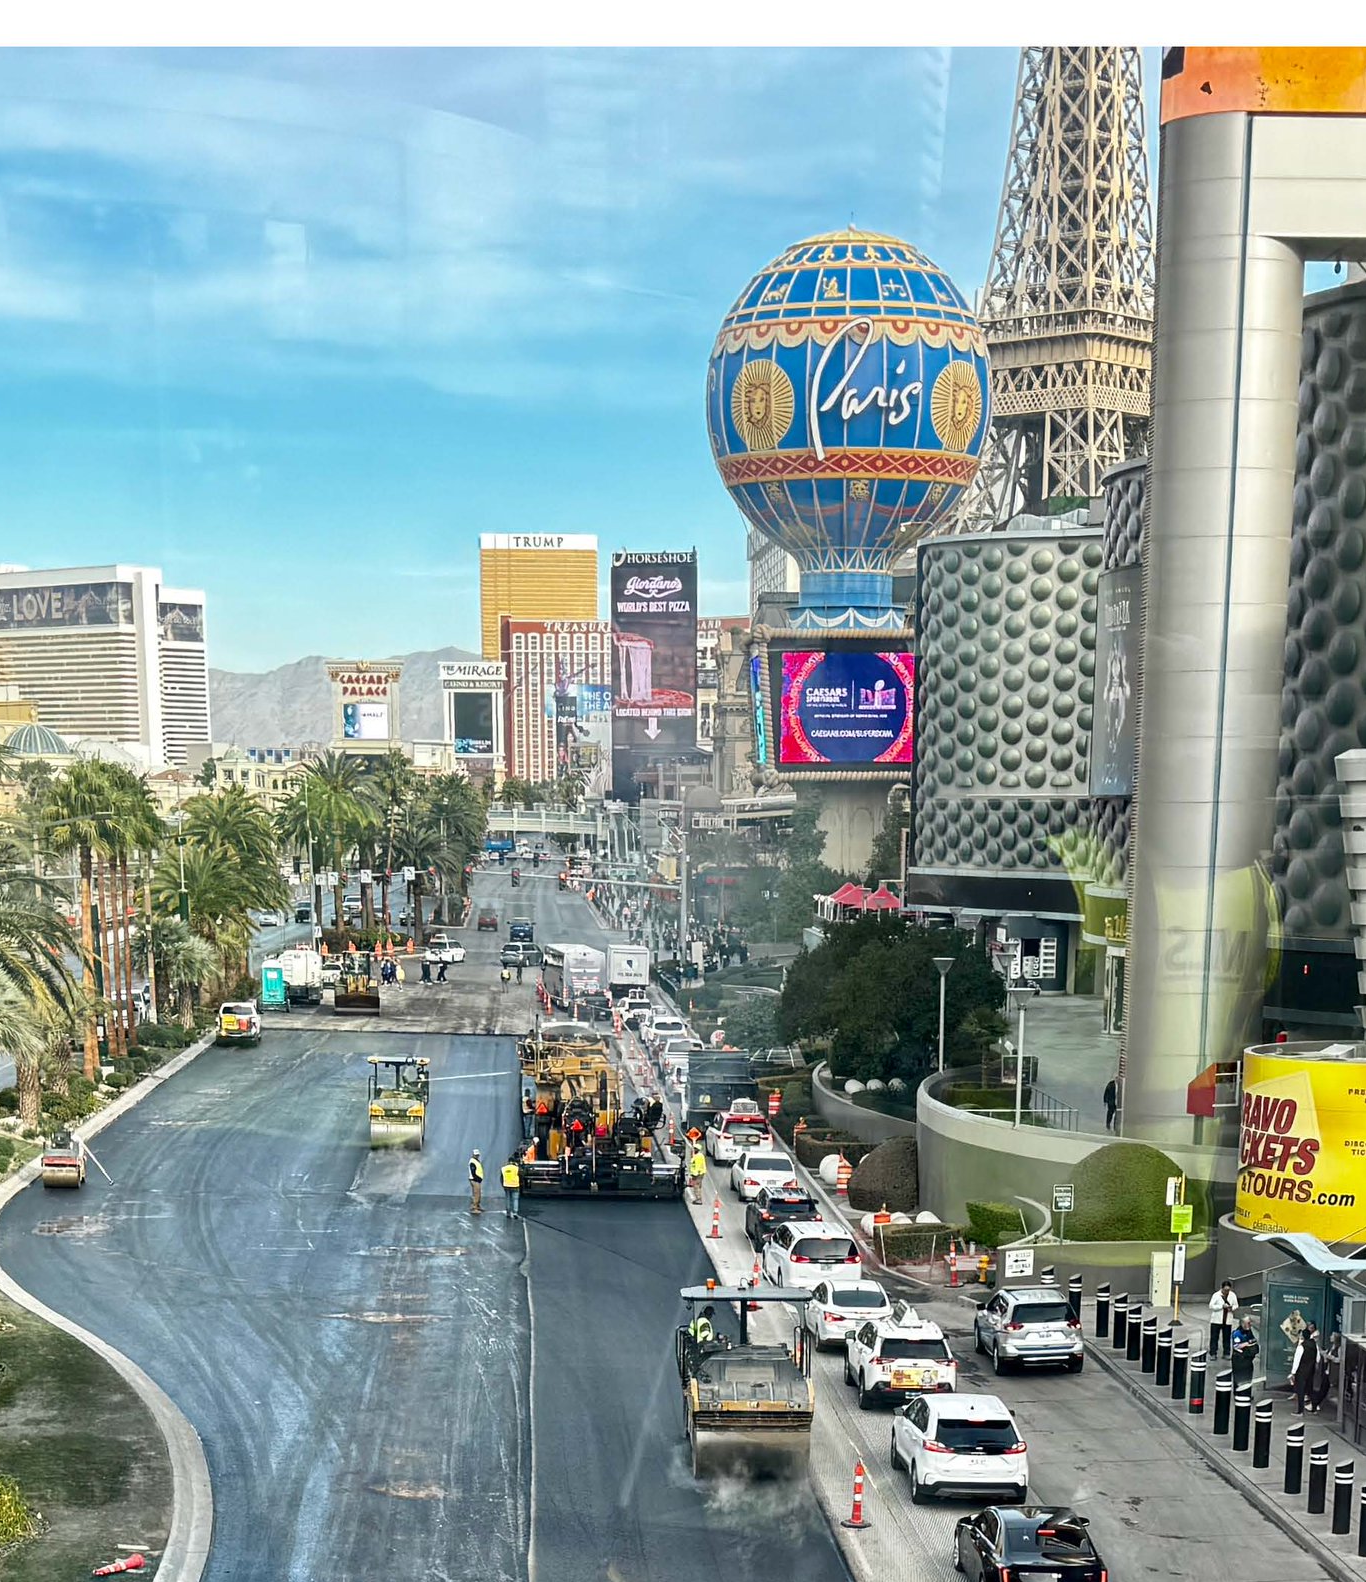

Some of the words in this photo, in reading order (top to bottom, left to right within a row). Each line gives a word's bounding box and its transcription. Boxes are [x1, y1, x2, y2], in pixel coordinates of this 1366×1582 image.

[811, 316, 923, 461] Paris
[513, 536, 564, 548] TRUMP
[627, 553, 694, 564] HORSESHOE
[13, 592, 63, 621] LOVE
[617, 601, 648, 613] WORLD'S
[668, 601, 691, 612] PIZZA
[448, 665, 503, 676] MIRAGE
[339, 674, 389, 685] CAESARS
[342, 686, 387, 696] PALACE
[806, 688, 847, 697] CAESARS
[1242, 1091, 1298, 1135] RAVO
[1240, 1128, 1320, 1176] CKETS
